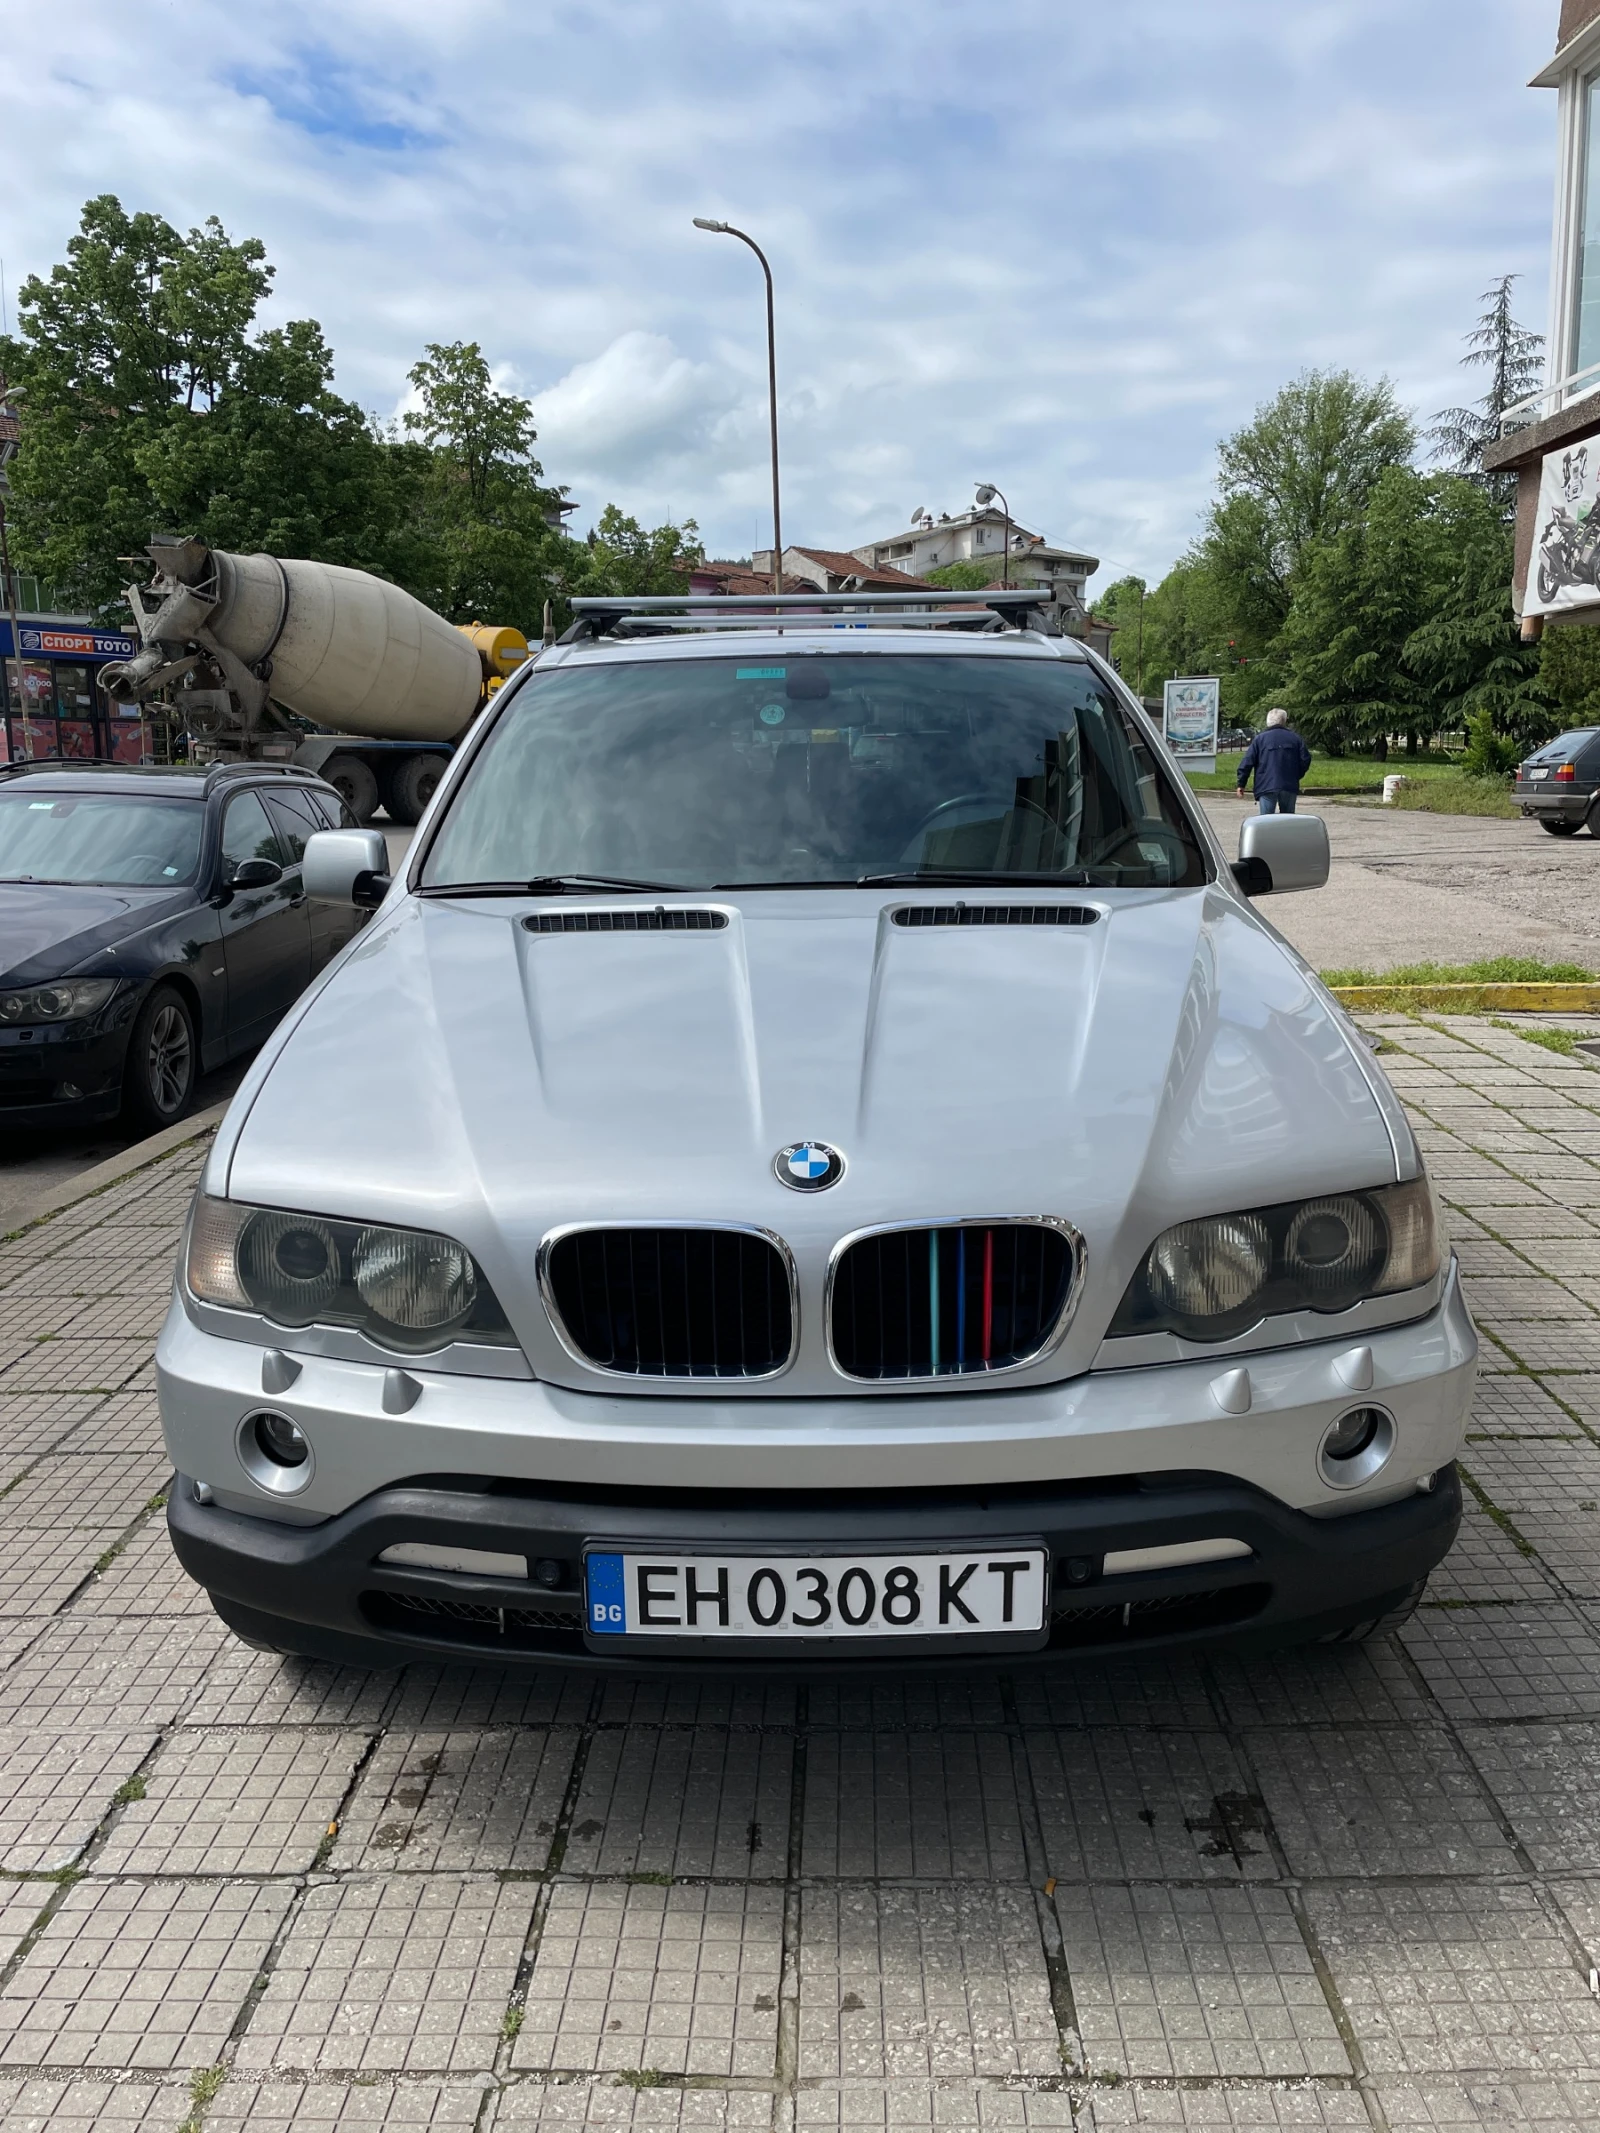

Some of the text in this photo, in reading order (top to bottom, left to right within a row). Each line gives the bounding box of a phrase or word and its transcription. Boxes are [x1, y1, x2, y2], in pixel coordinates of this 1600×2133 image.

[44, 636, 131, 652] СПОРТ ТОТО
[783, 1142, 835, 1156] BMW
[637, 1561, 1030, 1627] EH 0308 KT
[593, 1603, 622, 1622] BG
